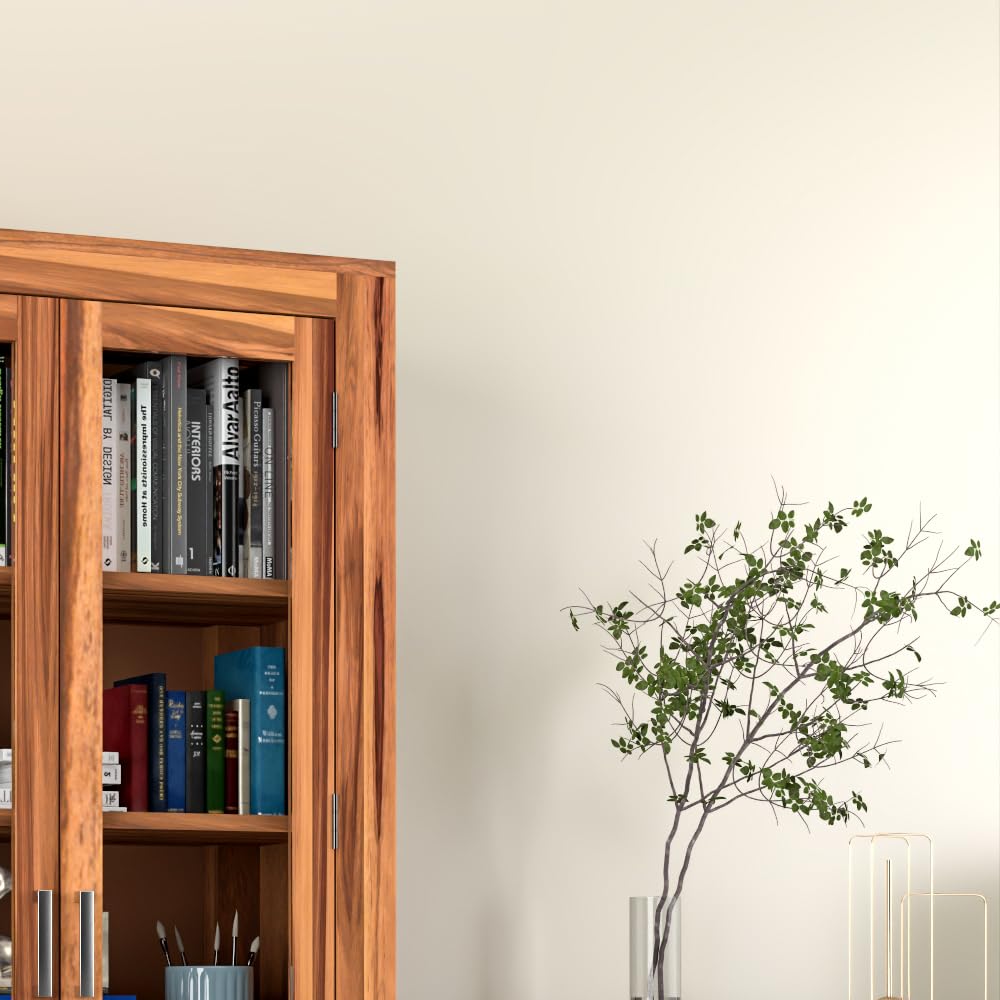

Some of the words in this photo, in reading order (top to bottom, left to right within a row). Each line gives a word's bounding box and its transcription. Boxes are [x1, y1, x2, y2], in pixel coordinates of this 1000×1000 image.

[222, 366, 239, 412] Aalto
[222, 414, 239, 460] Alvar
[252, 400, 261, 432] Picasso
[191, 421, 201, 481] INTERIORS
[252, 433, 261, 467] Guitars
